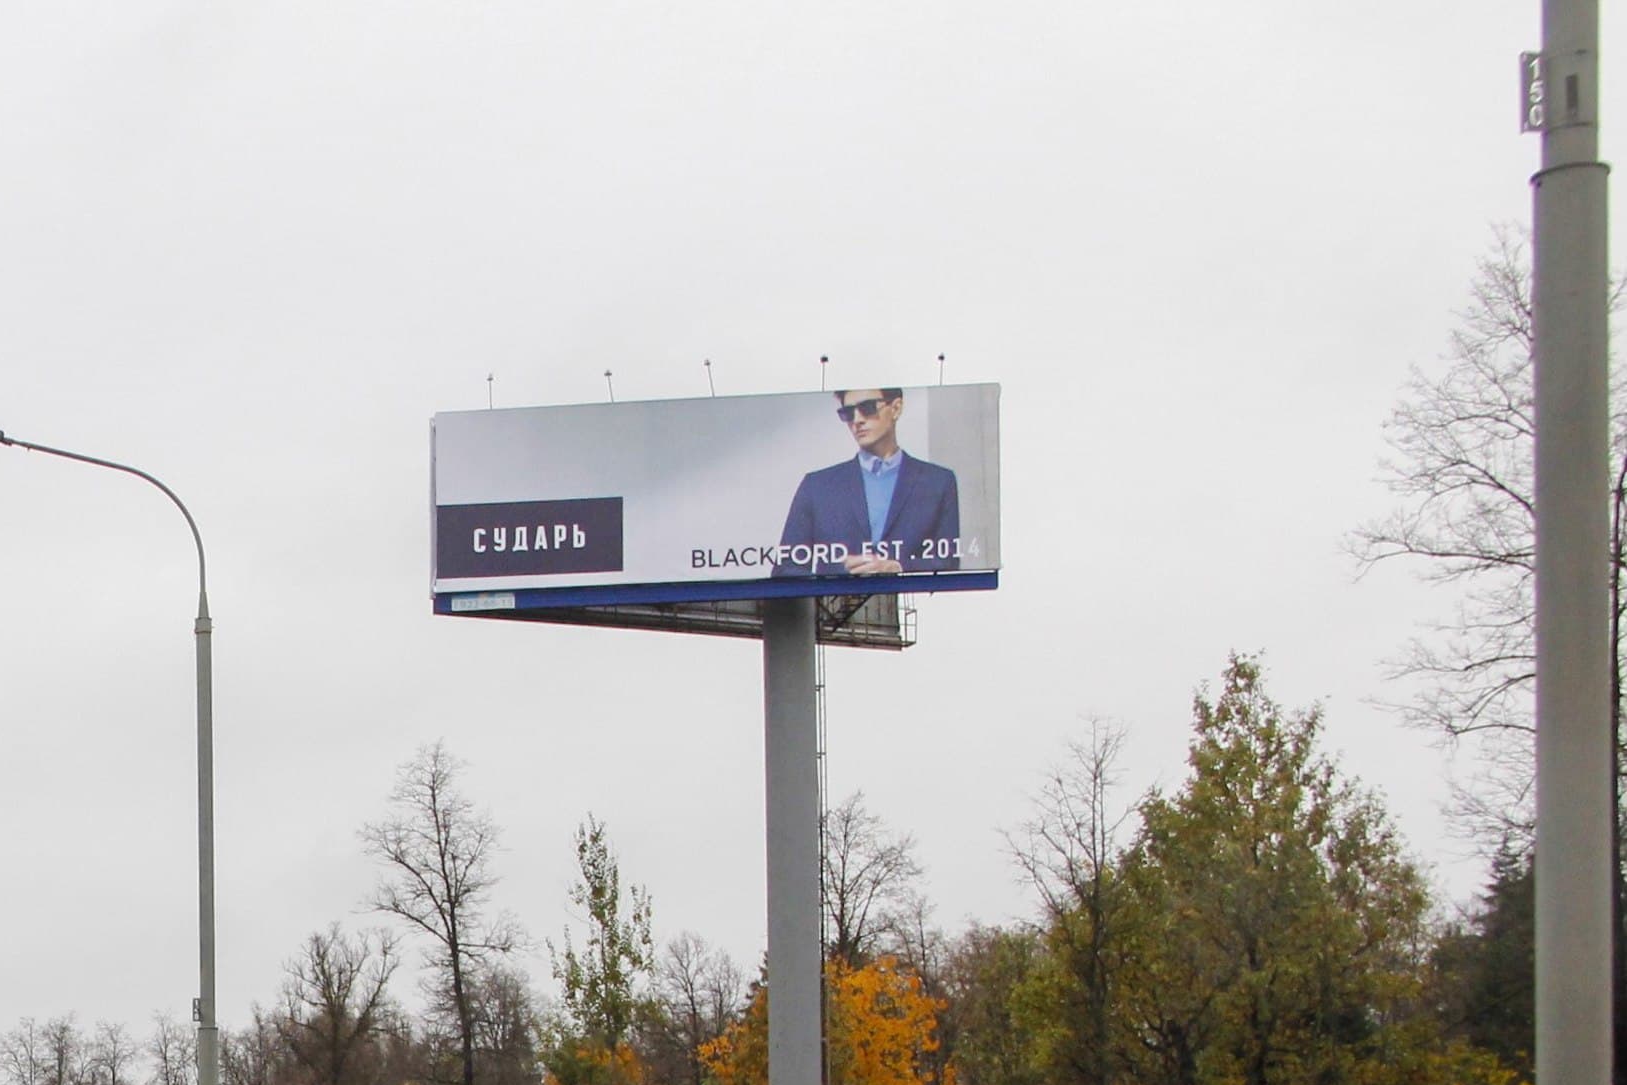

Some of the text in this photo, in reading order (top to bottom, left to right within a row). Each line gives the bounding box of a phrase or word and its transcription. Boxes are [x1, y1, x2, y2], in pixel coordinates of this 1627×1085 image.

[1529, 57, 1544, 127] 150
[473, 524, 586, 553] СУДАРЬ
[691, 543, 849, 574] BLACKFORD
